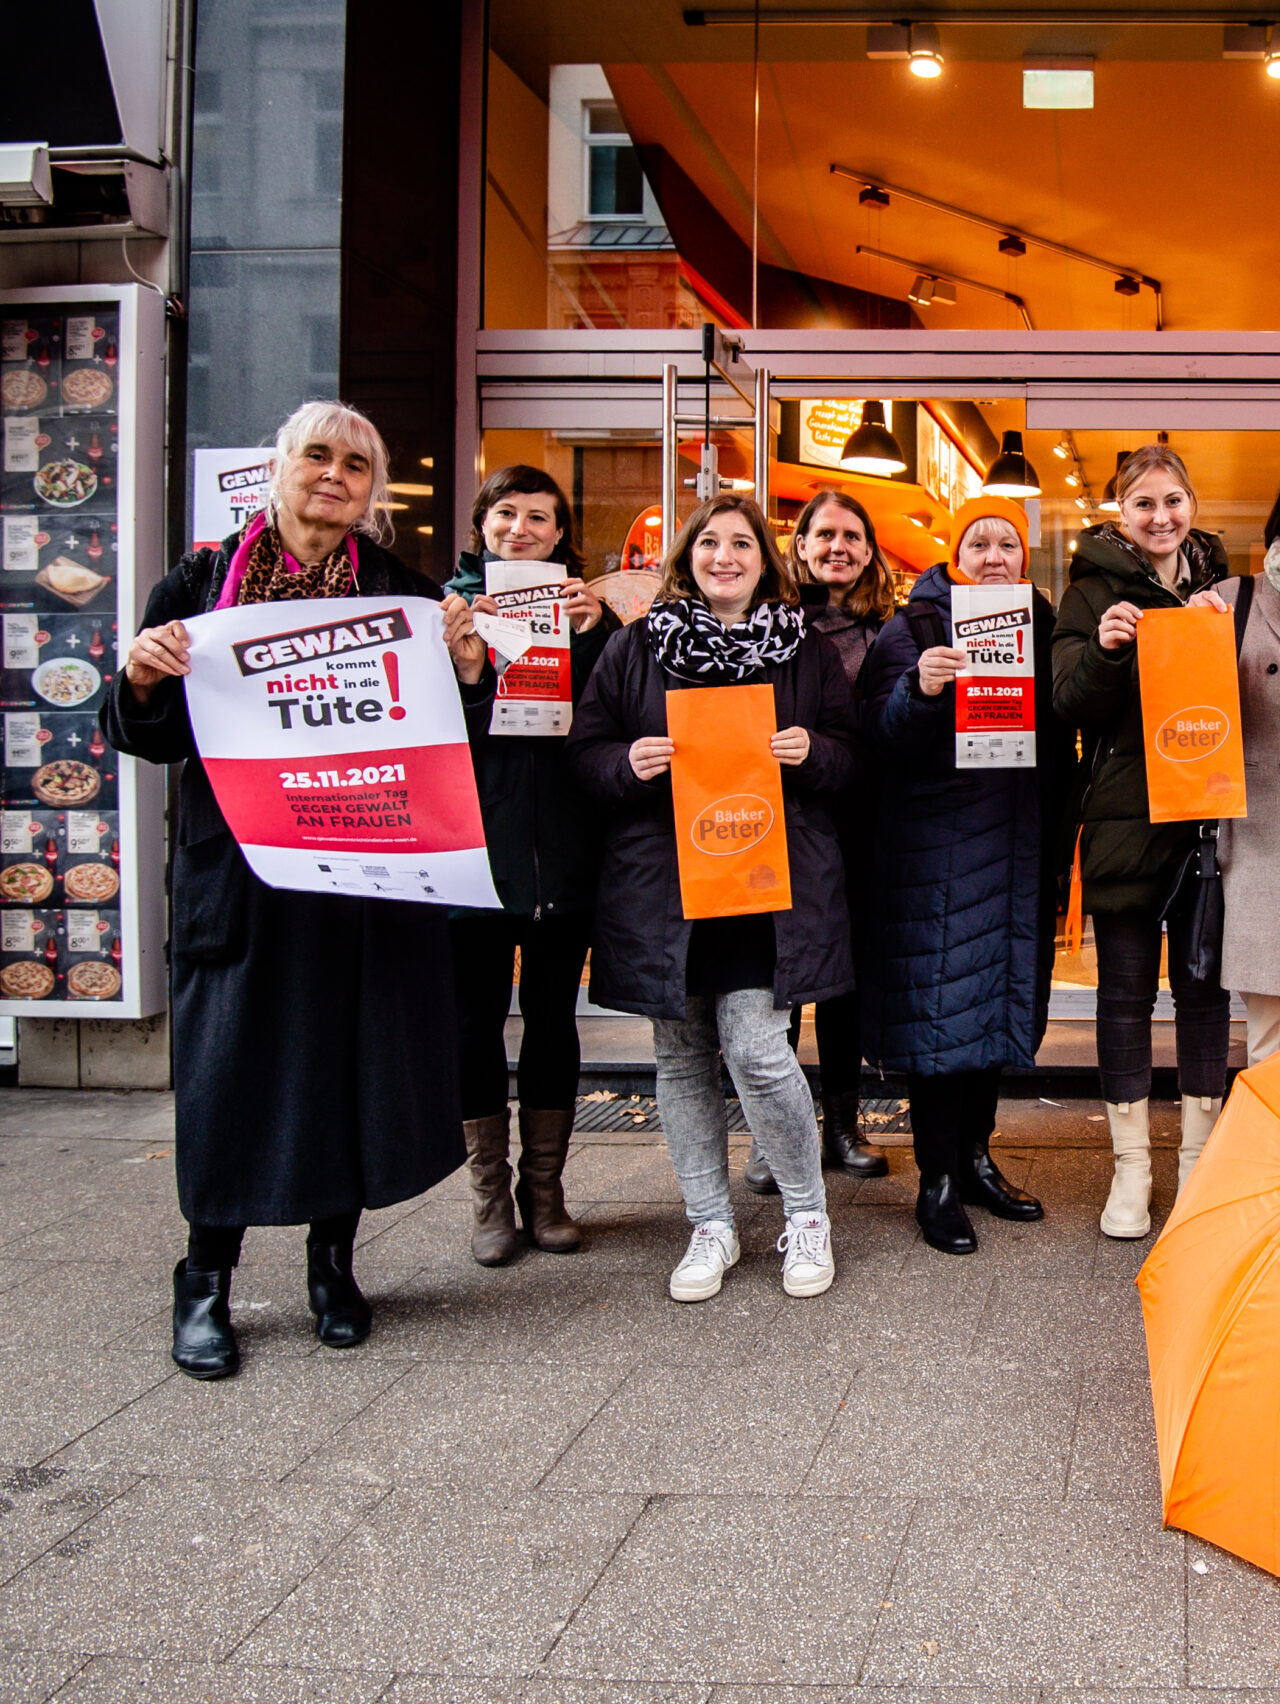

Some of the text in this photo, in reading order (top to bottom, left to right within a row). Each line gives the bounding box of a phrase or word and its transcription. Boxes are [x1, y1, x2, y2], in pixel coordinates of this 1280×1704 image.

[230, 492, 259, 503] nich
[494, 586, 561, 607] GEWALT
[502, 610, 533, 618] nicht
[958, 612, 1024, 636] GEWALT
[243, 616, 395, 670] GEWALT
[966, 638, 996, 647] nicht
[327, 660, 378, 670] kommt
[515, 656, 559, 667] .11.2021
[266, 673, 380, 694] nicht in die
[519, 681, 559, 689] FRAUEN
[967, 686, 1023, 697] 25.11.2021
[1177, 719, 1221, 732] Bäcker
[1162, 728, 1220, 748] Peter
[279, 764, 406, 789] 25.11.2021
[286, 789, 408, 802] Internationaler Tag
[290, 800, 408, 814] GEGEN GEWALT
[296, 813, 412, 828] AN FRAUEN
[715, 808, 765, 823] Bäcker
[699, 819, 764, 841] Peter
